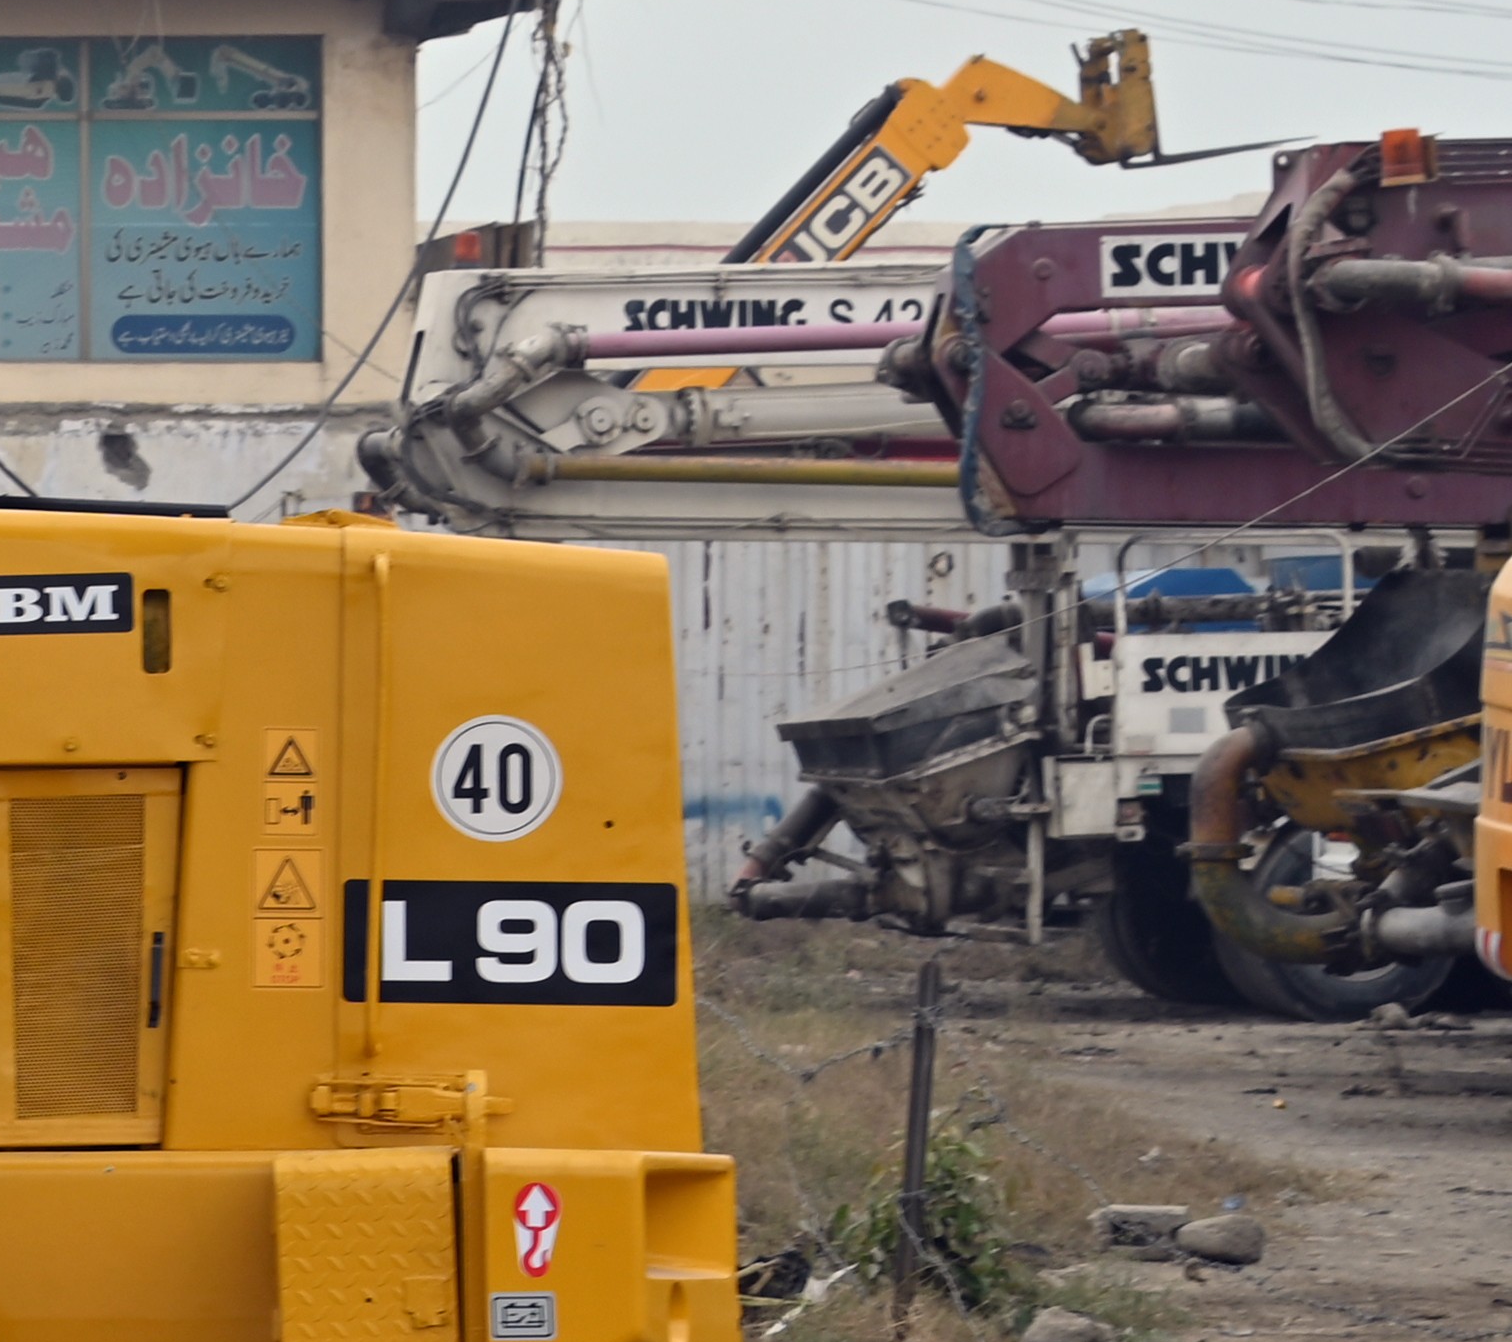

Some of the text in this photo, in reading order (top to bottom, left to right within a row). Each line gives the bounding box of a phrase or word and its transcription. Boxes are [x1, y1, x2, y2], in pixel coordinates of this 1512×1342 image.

[102, 133, 307, 227] خانزادہ
[790, 161, 905, 260] JCB
[453, 742, 533, 815] 40
[381, 898, 647, 986] L 90
